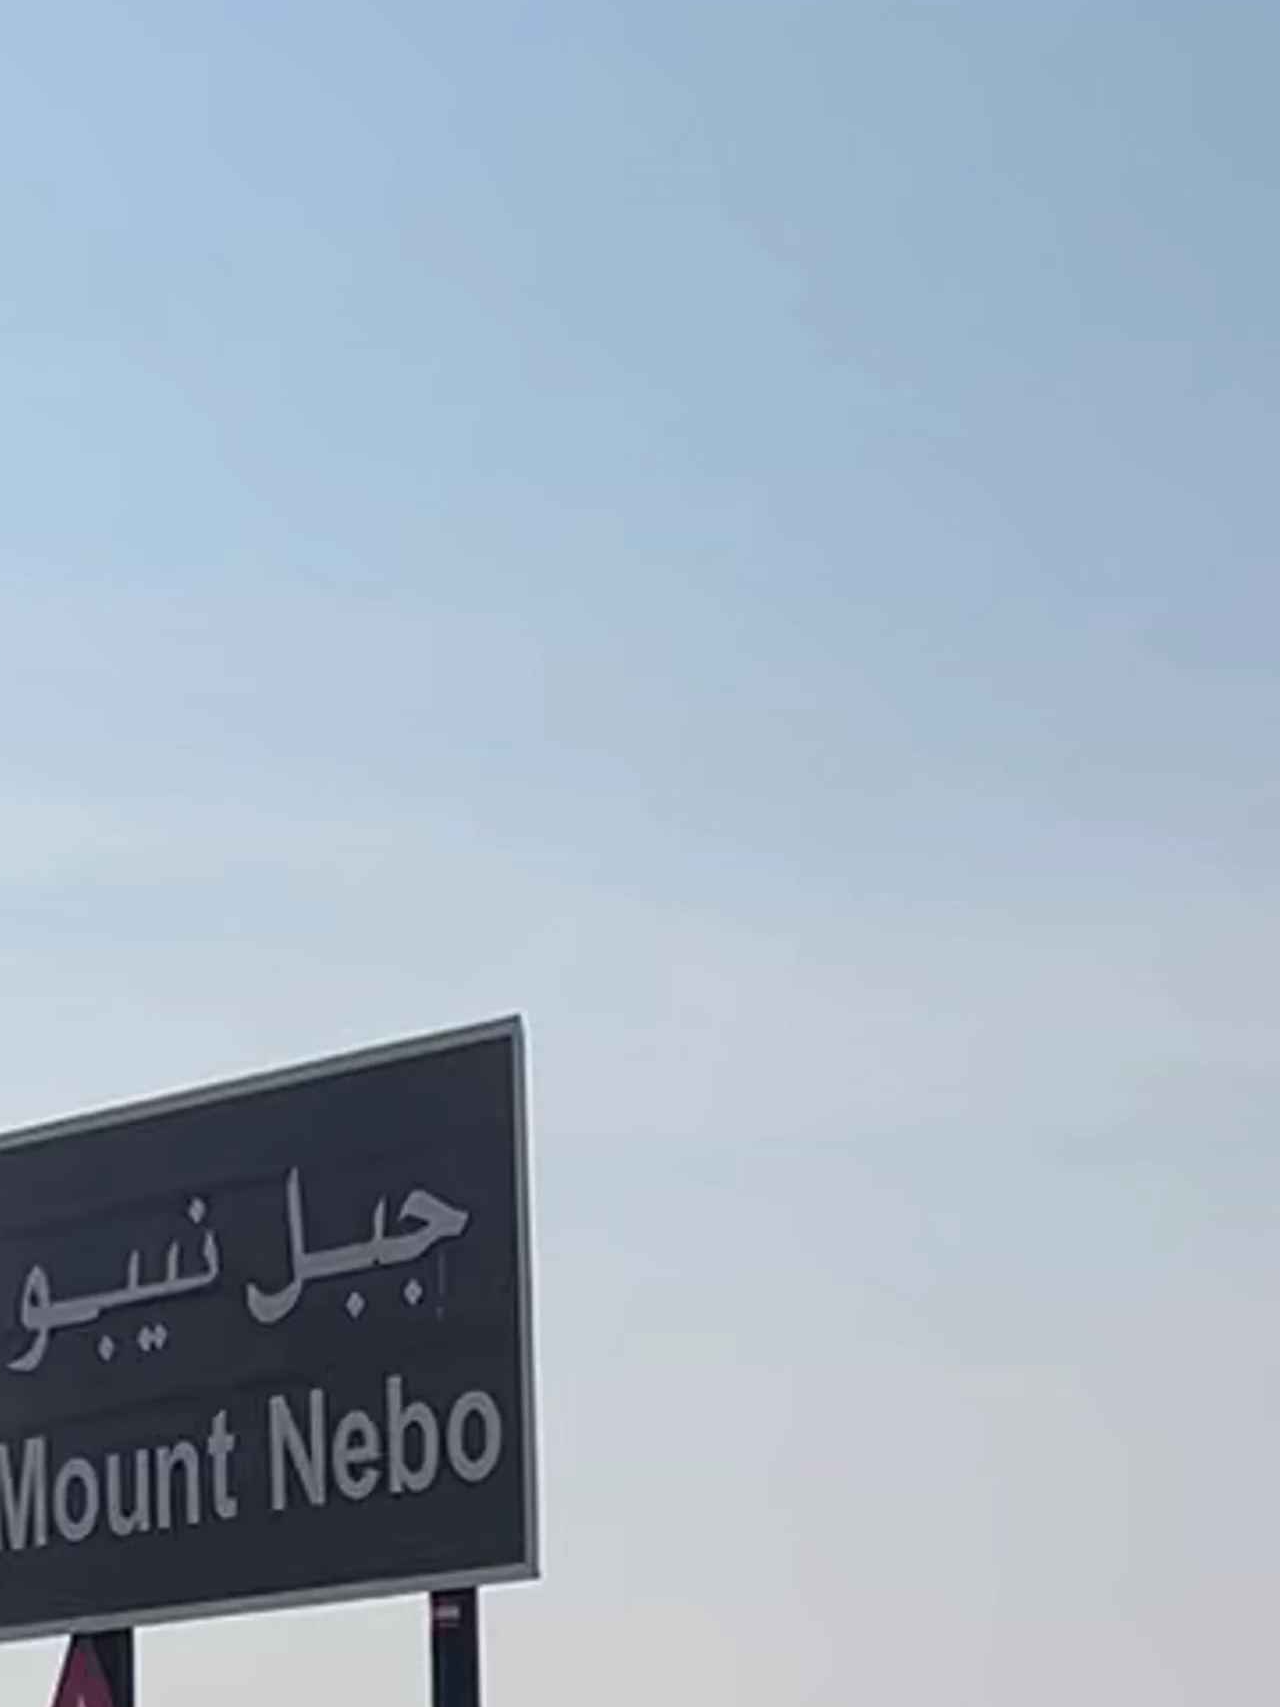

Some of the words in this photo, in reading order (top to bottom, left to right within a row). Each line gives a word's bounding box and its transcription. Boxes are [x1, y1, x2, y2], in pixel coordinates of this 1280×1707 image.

[7, 1196, 219, 1372] نيبو
[246, 1166, 470, 1324] جبل
[268, 1374, 503, 1512] Nebo
